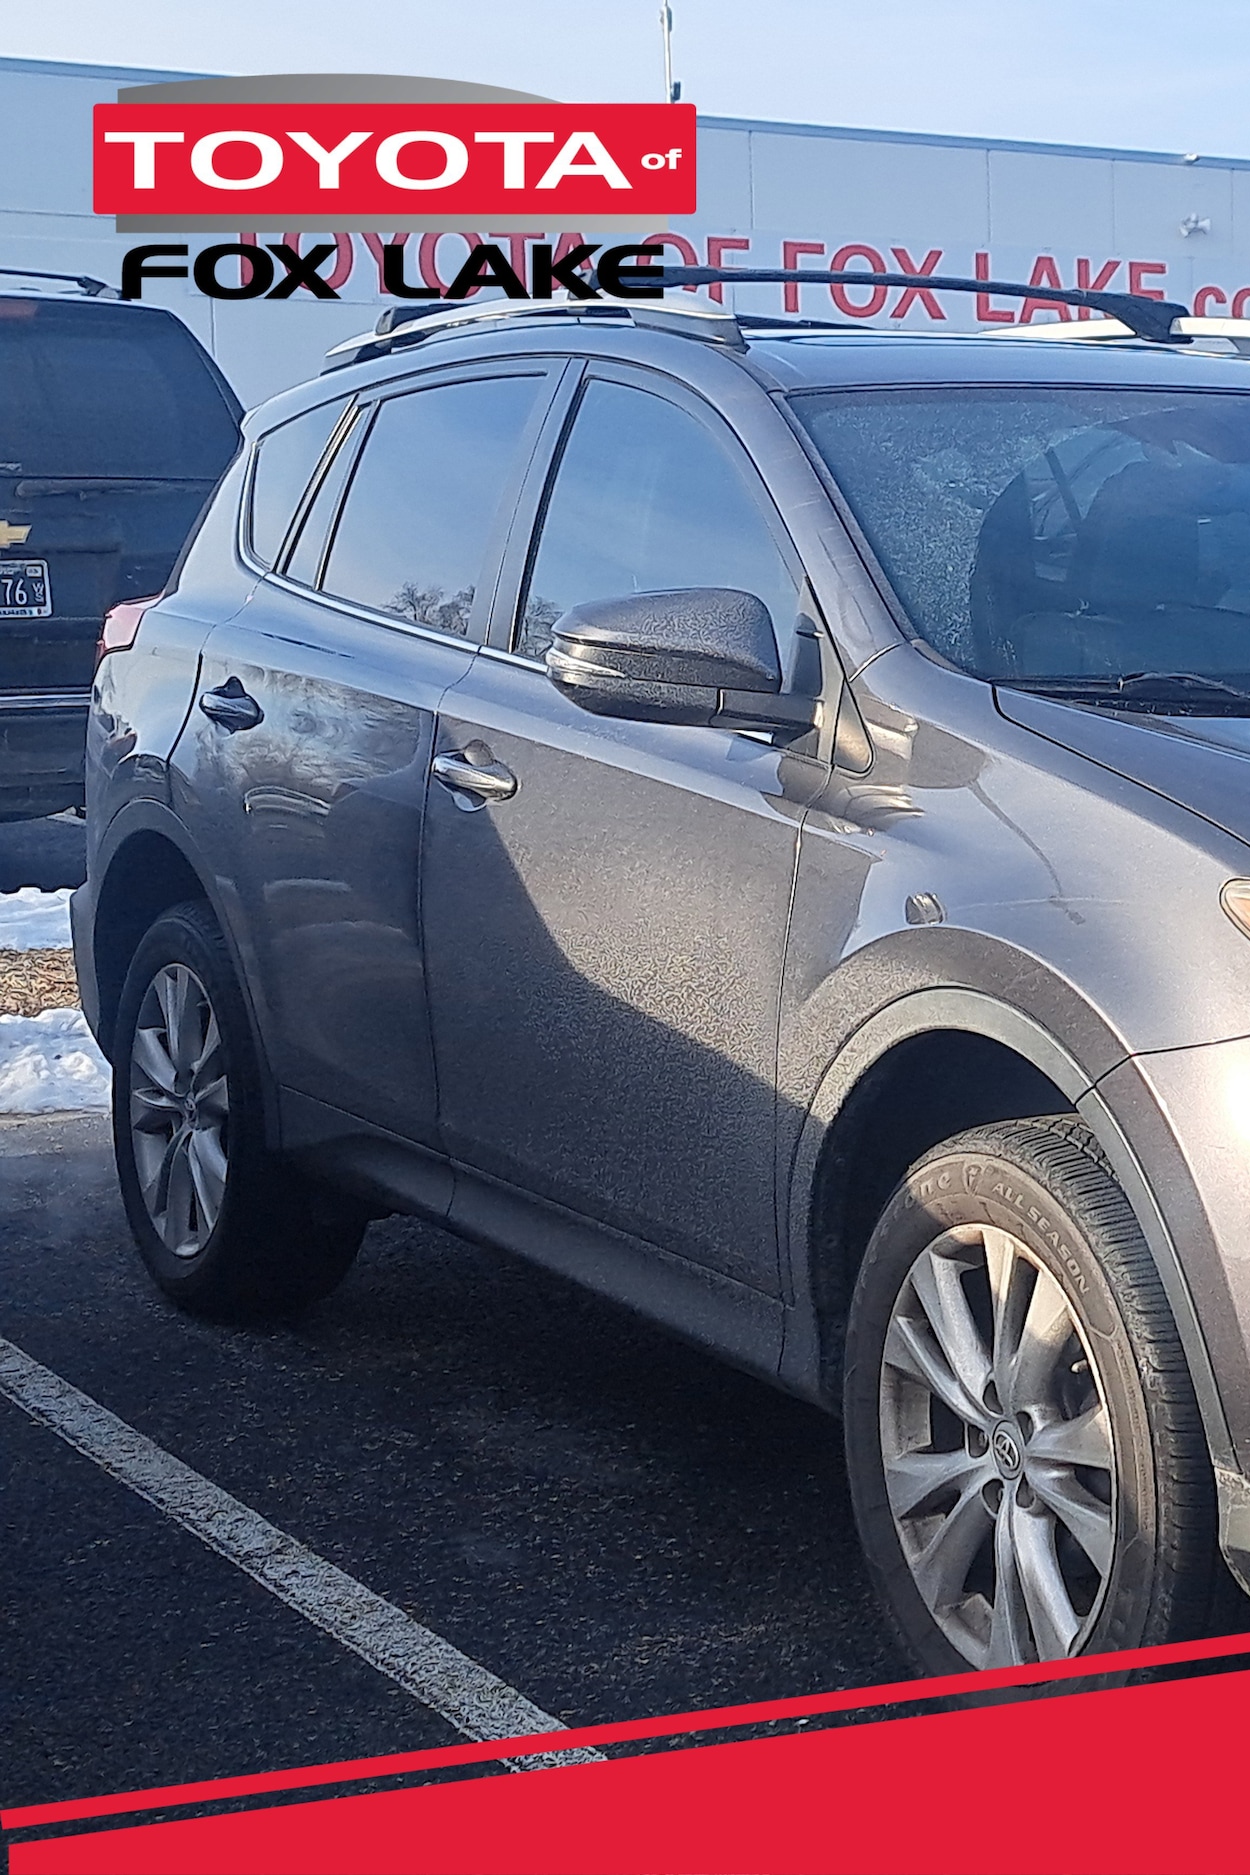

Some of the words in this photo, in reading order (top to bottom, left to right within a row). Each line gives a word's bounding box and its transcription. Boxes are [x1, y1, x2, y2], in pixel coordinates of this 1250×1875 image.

[782, 240, 947, 320] FOX
[974, 252, 1167, 324] LAKE
[992, 1182, 1025, 1210] ALL
[1027, 1206, 1090, 1295] SEASON
